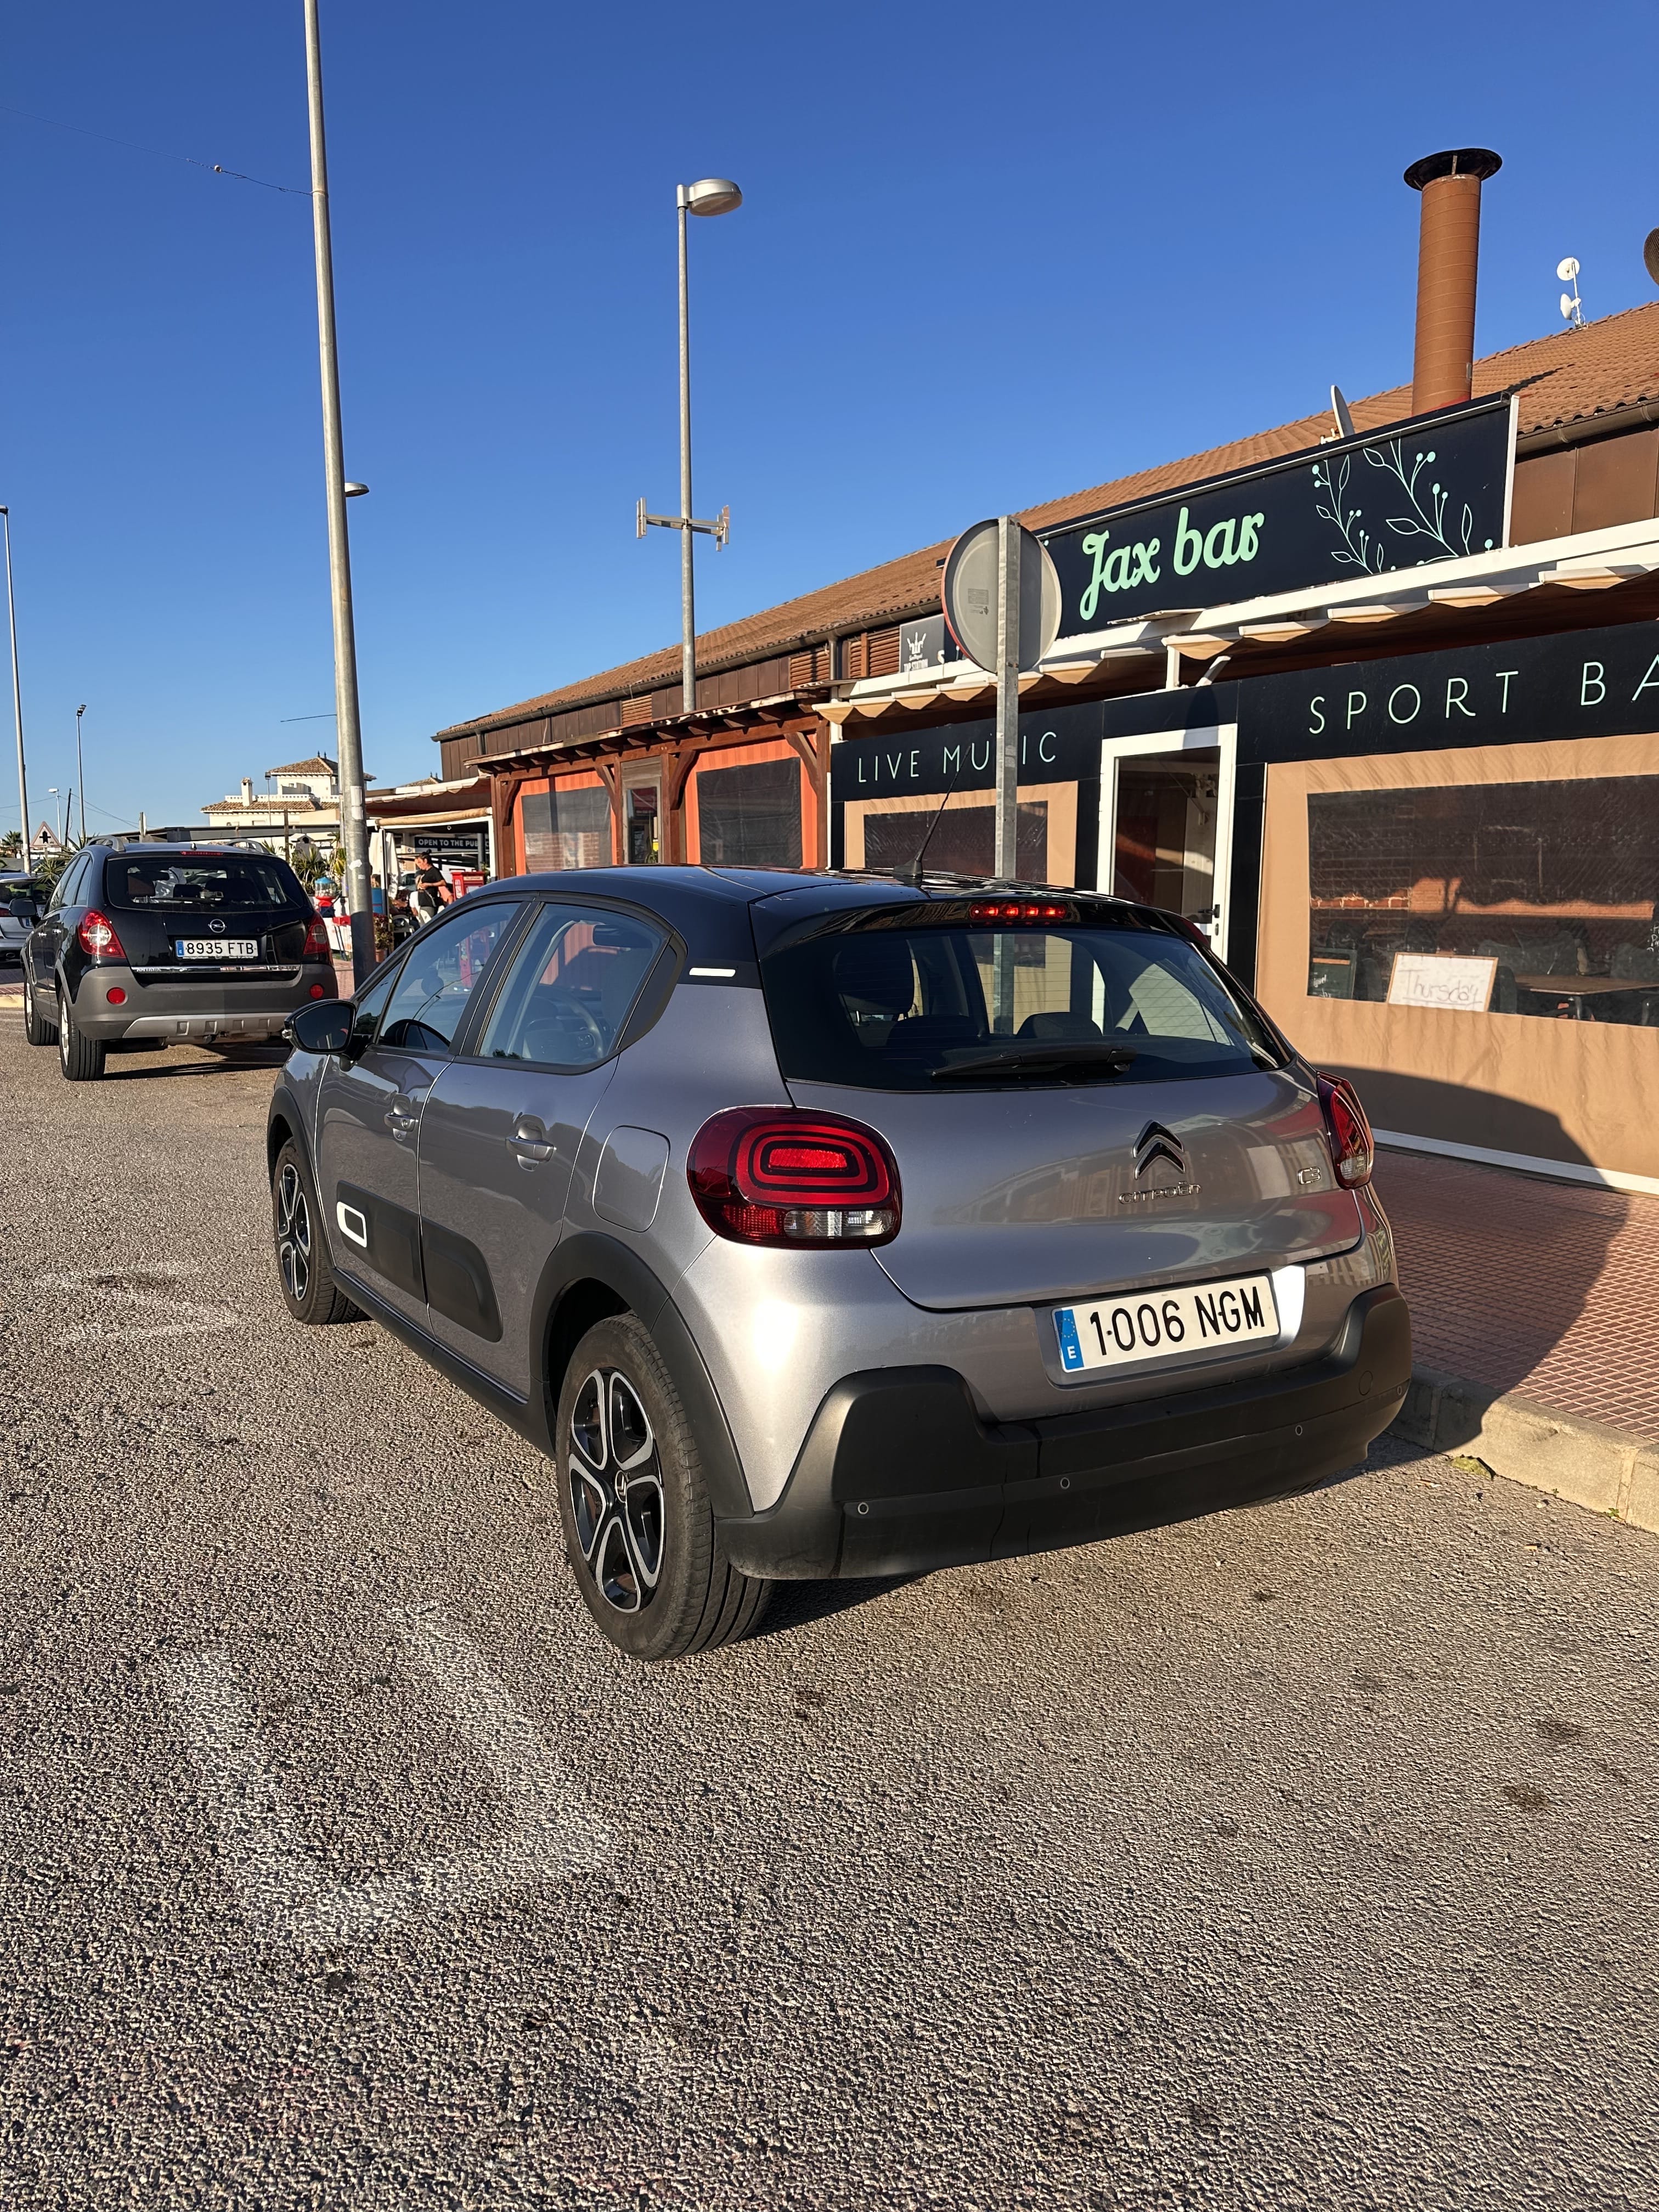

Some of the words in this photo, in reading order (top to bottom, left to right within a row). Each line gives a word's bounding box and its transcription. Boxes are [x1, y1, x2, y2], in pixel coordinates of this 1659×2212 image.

[1080, 530, 1161, 621] Jax
[1173, 506, 1265, 575] bar
[1309, 670, 1519, 734] SPORT
[859, 750, 920, 783] LIVE
[943, 731, 1057, 774] MUIC
[187, 942, 223, 955] 8935
[228, 942, 254, 955] FTB
[1398, 969, 1479, 1009] Thursday
[1297, 1166, 1322, 1185] C3
[1090, 1300, 1185, 1356] 1006
[1194, 1286, 1265, 1338] NGM
[1067, 1346, 1076, 1359] E
